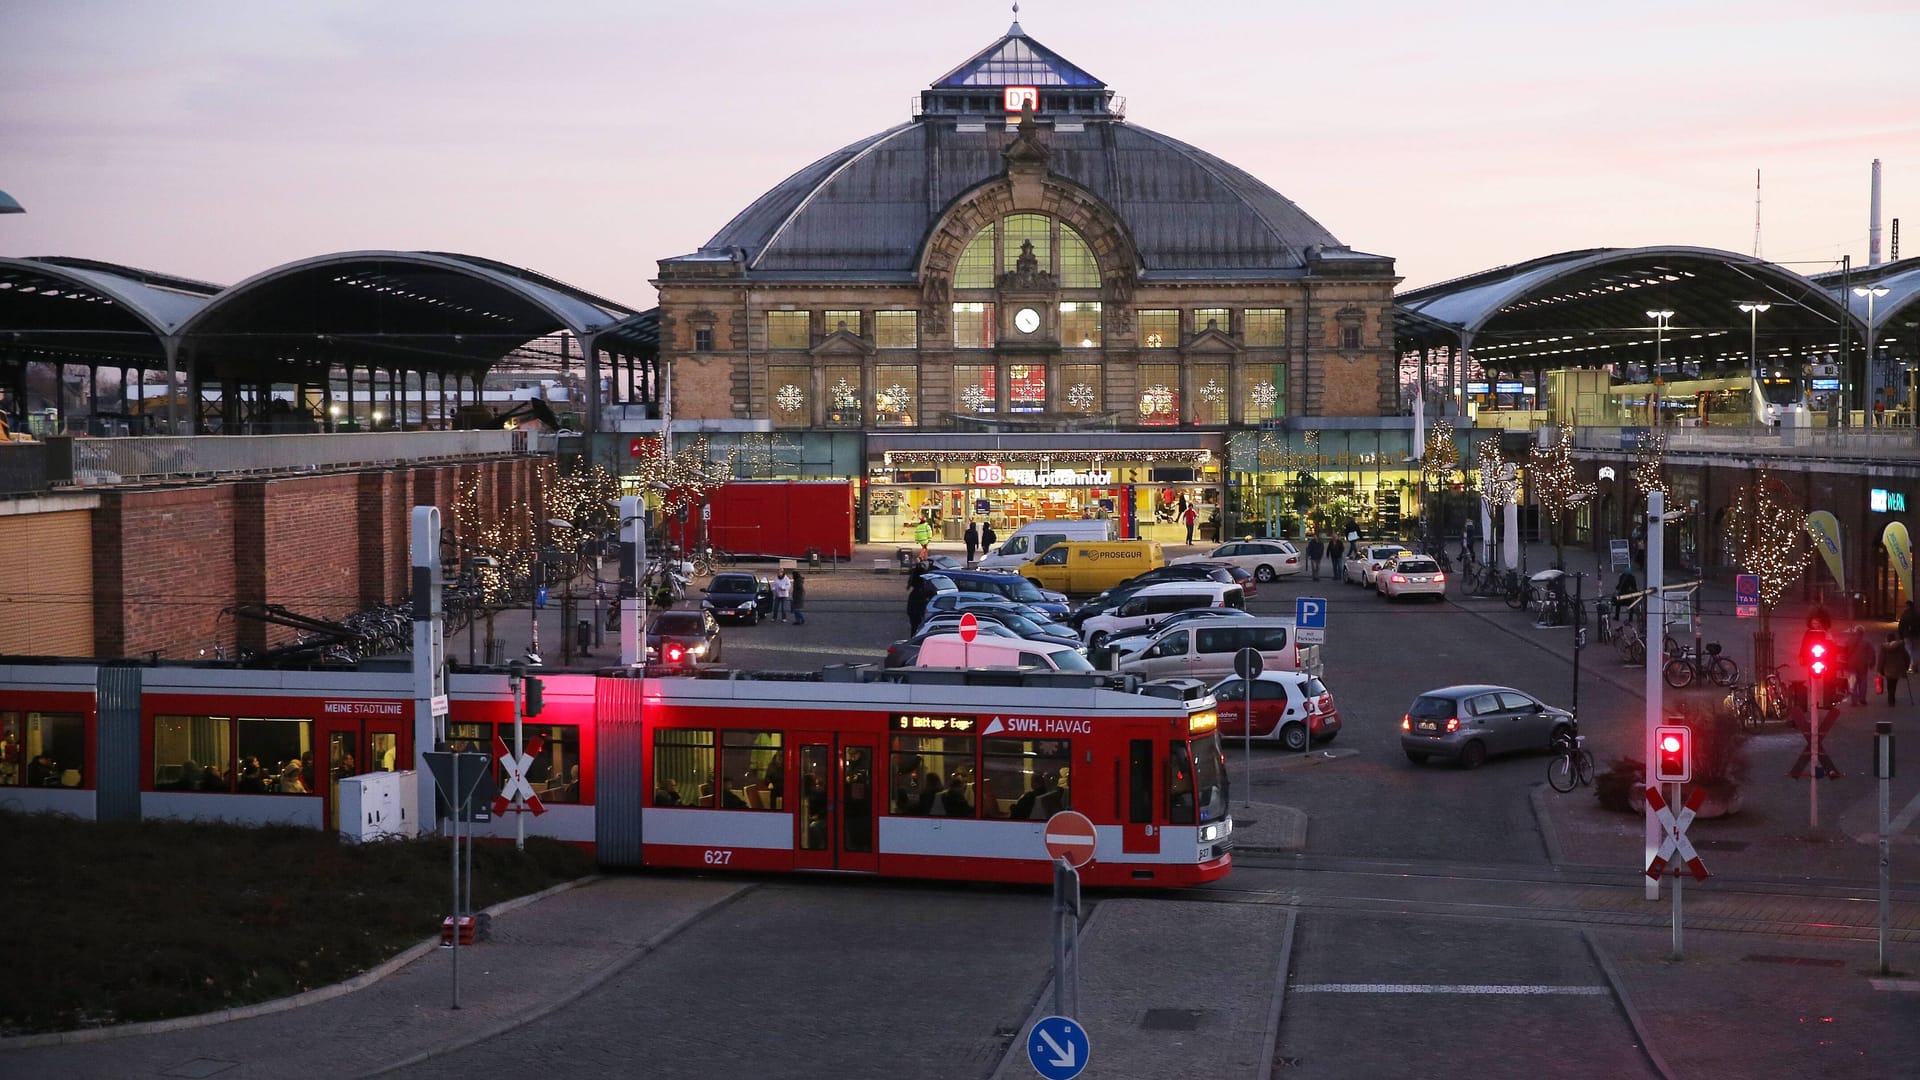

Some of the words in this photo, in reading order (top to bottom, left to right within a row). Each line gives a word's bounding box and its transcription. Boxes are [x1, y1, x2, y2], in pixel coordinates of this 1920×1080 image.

[1010, 92, 1034, 107] DB
[978, 467, 1000, 481] DB
[1014, 471, 1112, 488] Hauptbahnhof
[1100, 551, 1142, 559] PROSEGUR
[1303, 602, 1319, 624] P
[325, 703, 352, 713] MEINE
[354, 704, 402, 714] STADTLINIE
[900, 716, 908, 728] 9
[1008, 718, 1042, 732] SWH.
[1045, 719, 1091, 734] HAVAG
[704, 850, 732, 864] 627
